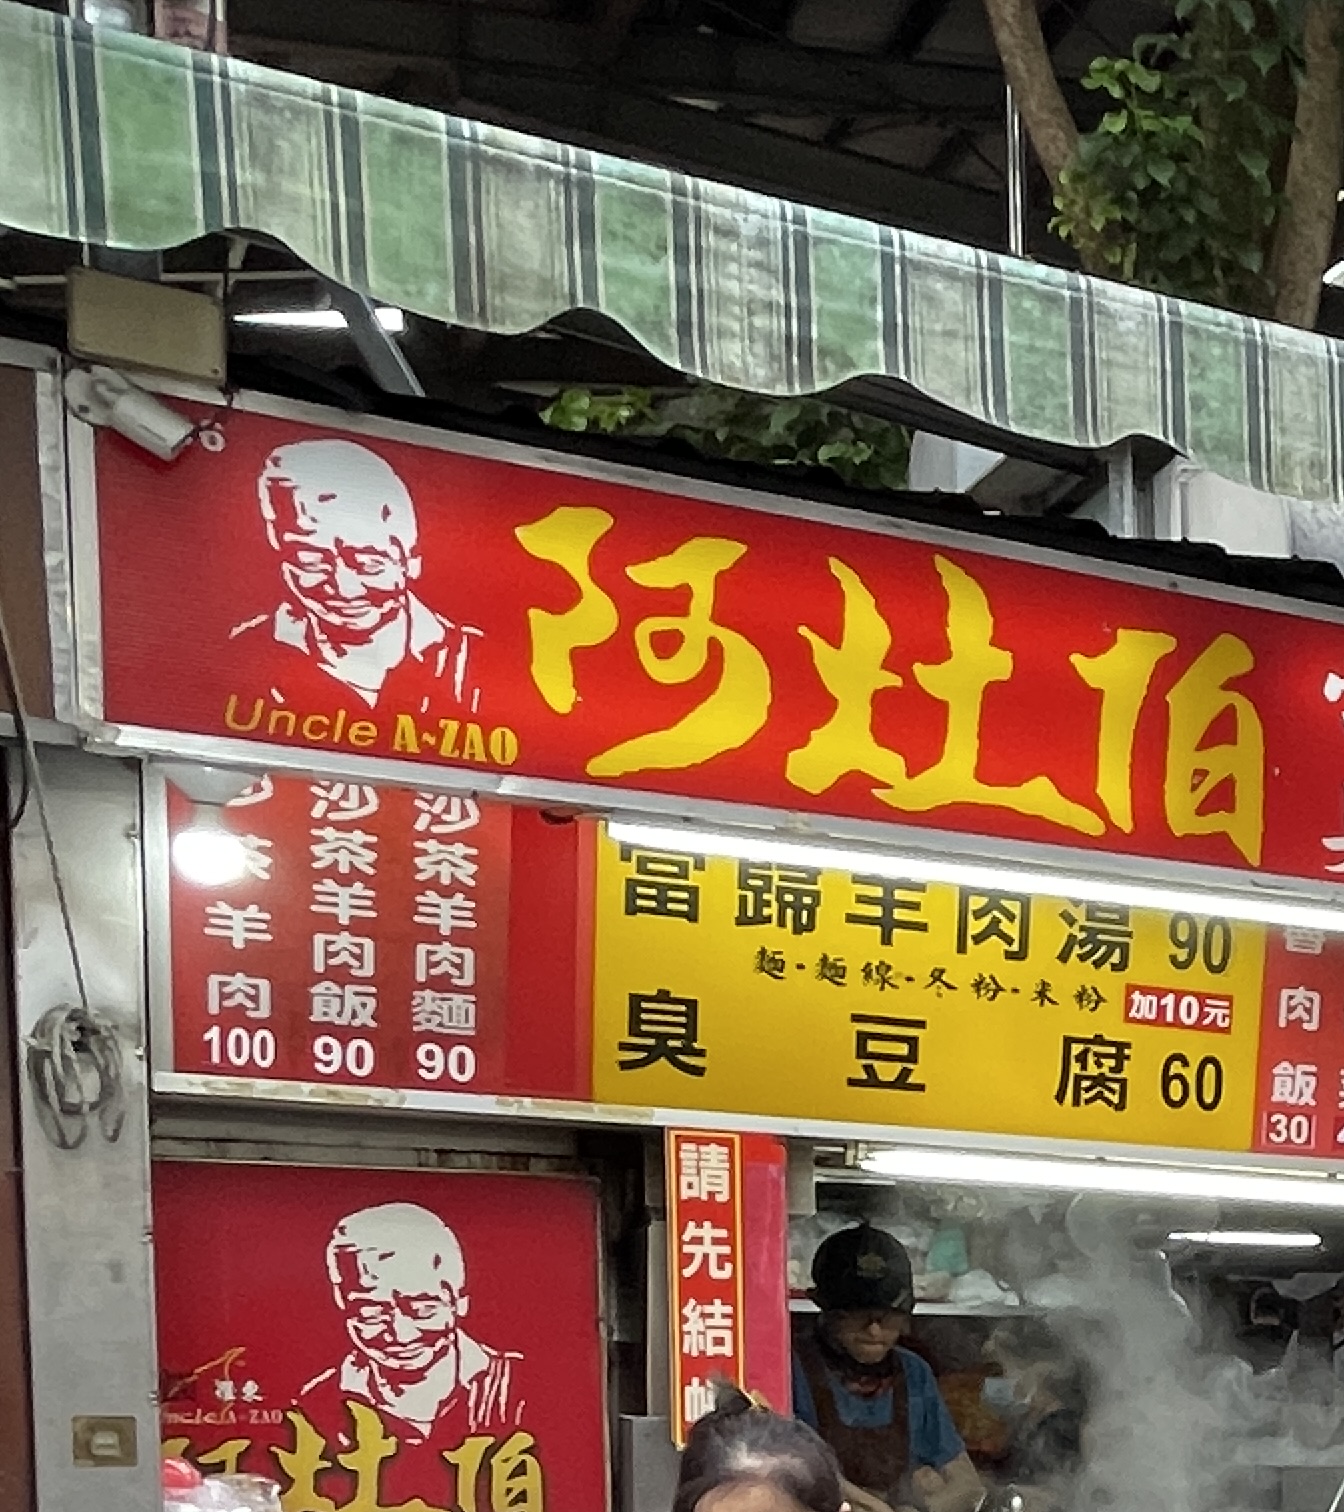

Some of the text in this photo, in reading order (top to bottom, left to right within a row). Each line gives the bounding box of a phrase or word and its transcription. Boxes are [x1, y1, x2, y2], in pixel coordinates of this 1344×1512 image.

[514, 505, 1267, 868] 阿灶伯
[225, 694, 378, 746] Uncle
[309, 779, 380, 1028] 沙茶羊肉飯
[411, 790, 481, 1037] 沙茶羊肉麵
[1168, 911, 1233, 975] 90
[1128, 989, 1231, 1028] 加10元
[202, 1025, 277, 1069] 100
[312, 1034, 375, 1078] 90
[415, 1042, 477, 1083] 90
[616, 988, 1133, 1112] 臭豆腐
[1160, 1052, 1224, 1112] 60
[1268, 1113, 1310, 1144] 30
